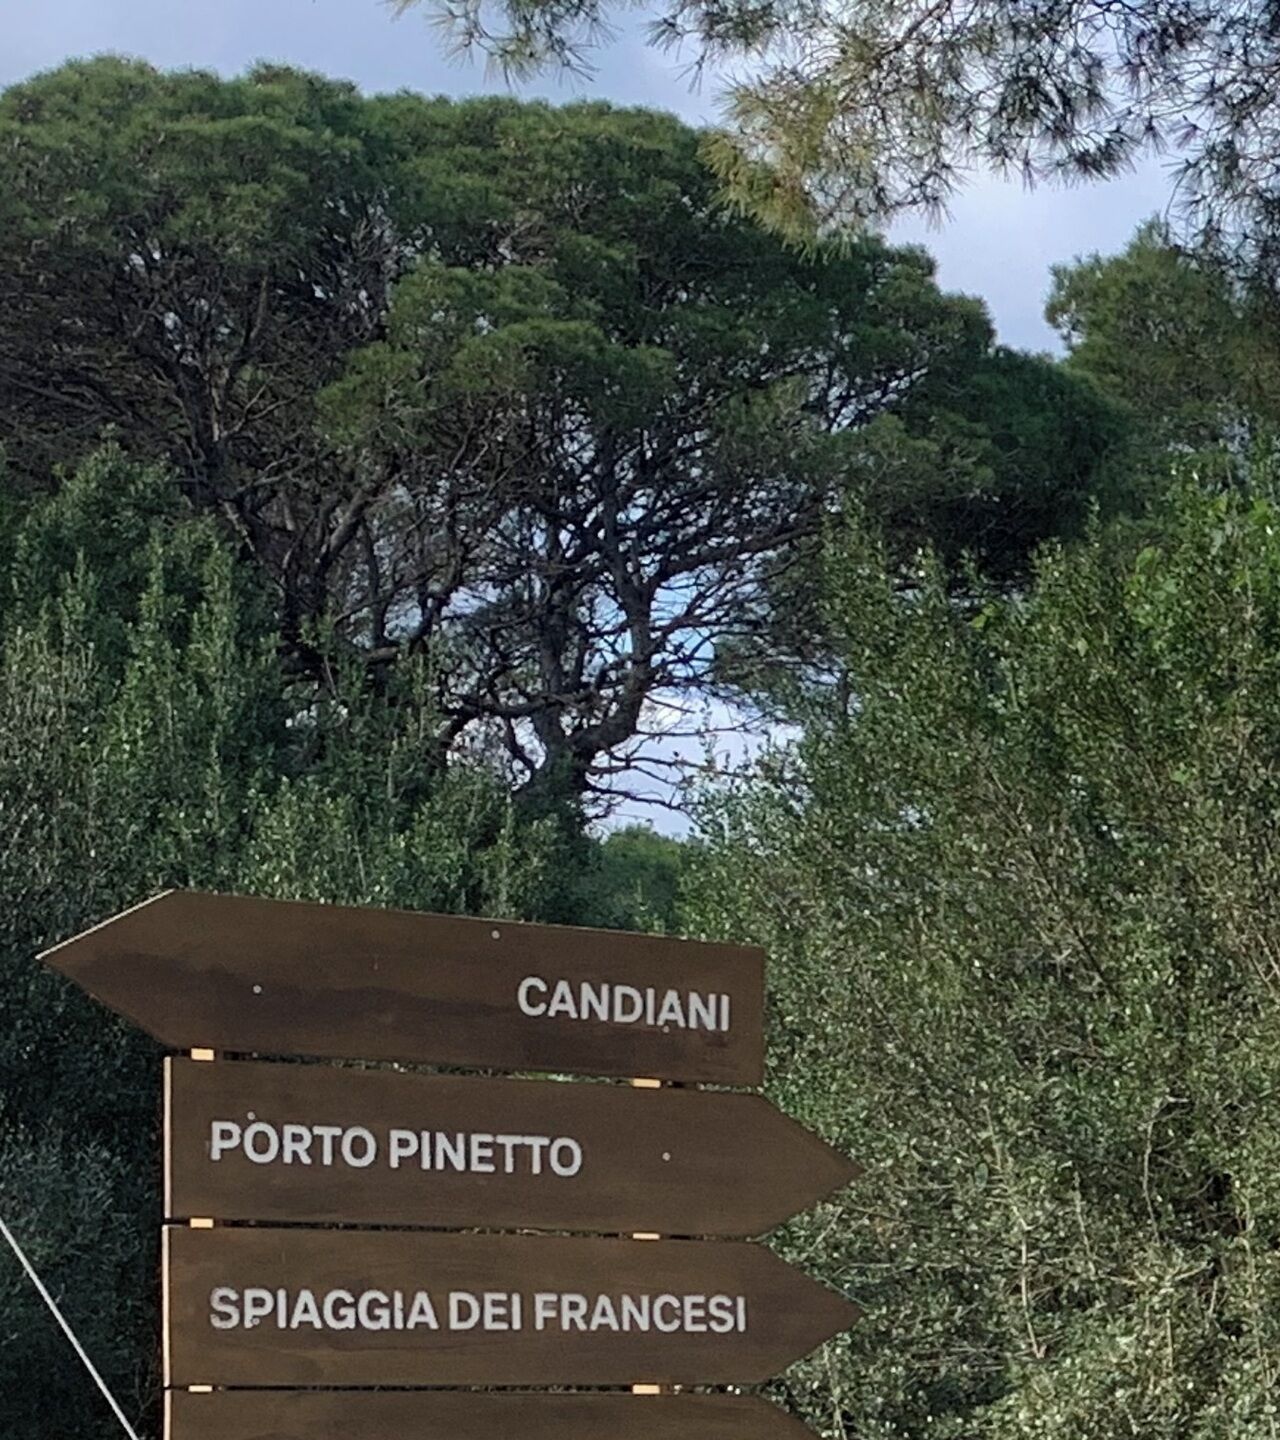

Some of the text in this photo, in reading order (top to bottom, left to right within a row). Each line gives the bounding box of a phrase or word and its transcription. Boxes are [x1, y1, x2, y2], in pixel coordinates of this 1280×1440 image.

[517, 977, 730, 1032] CANDIANI
[210, 1121, 582, 1176] PORTO PINETTO
[210, 1287, 746, 1333] SPIAGGIA DEI FRANCESI
